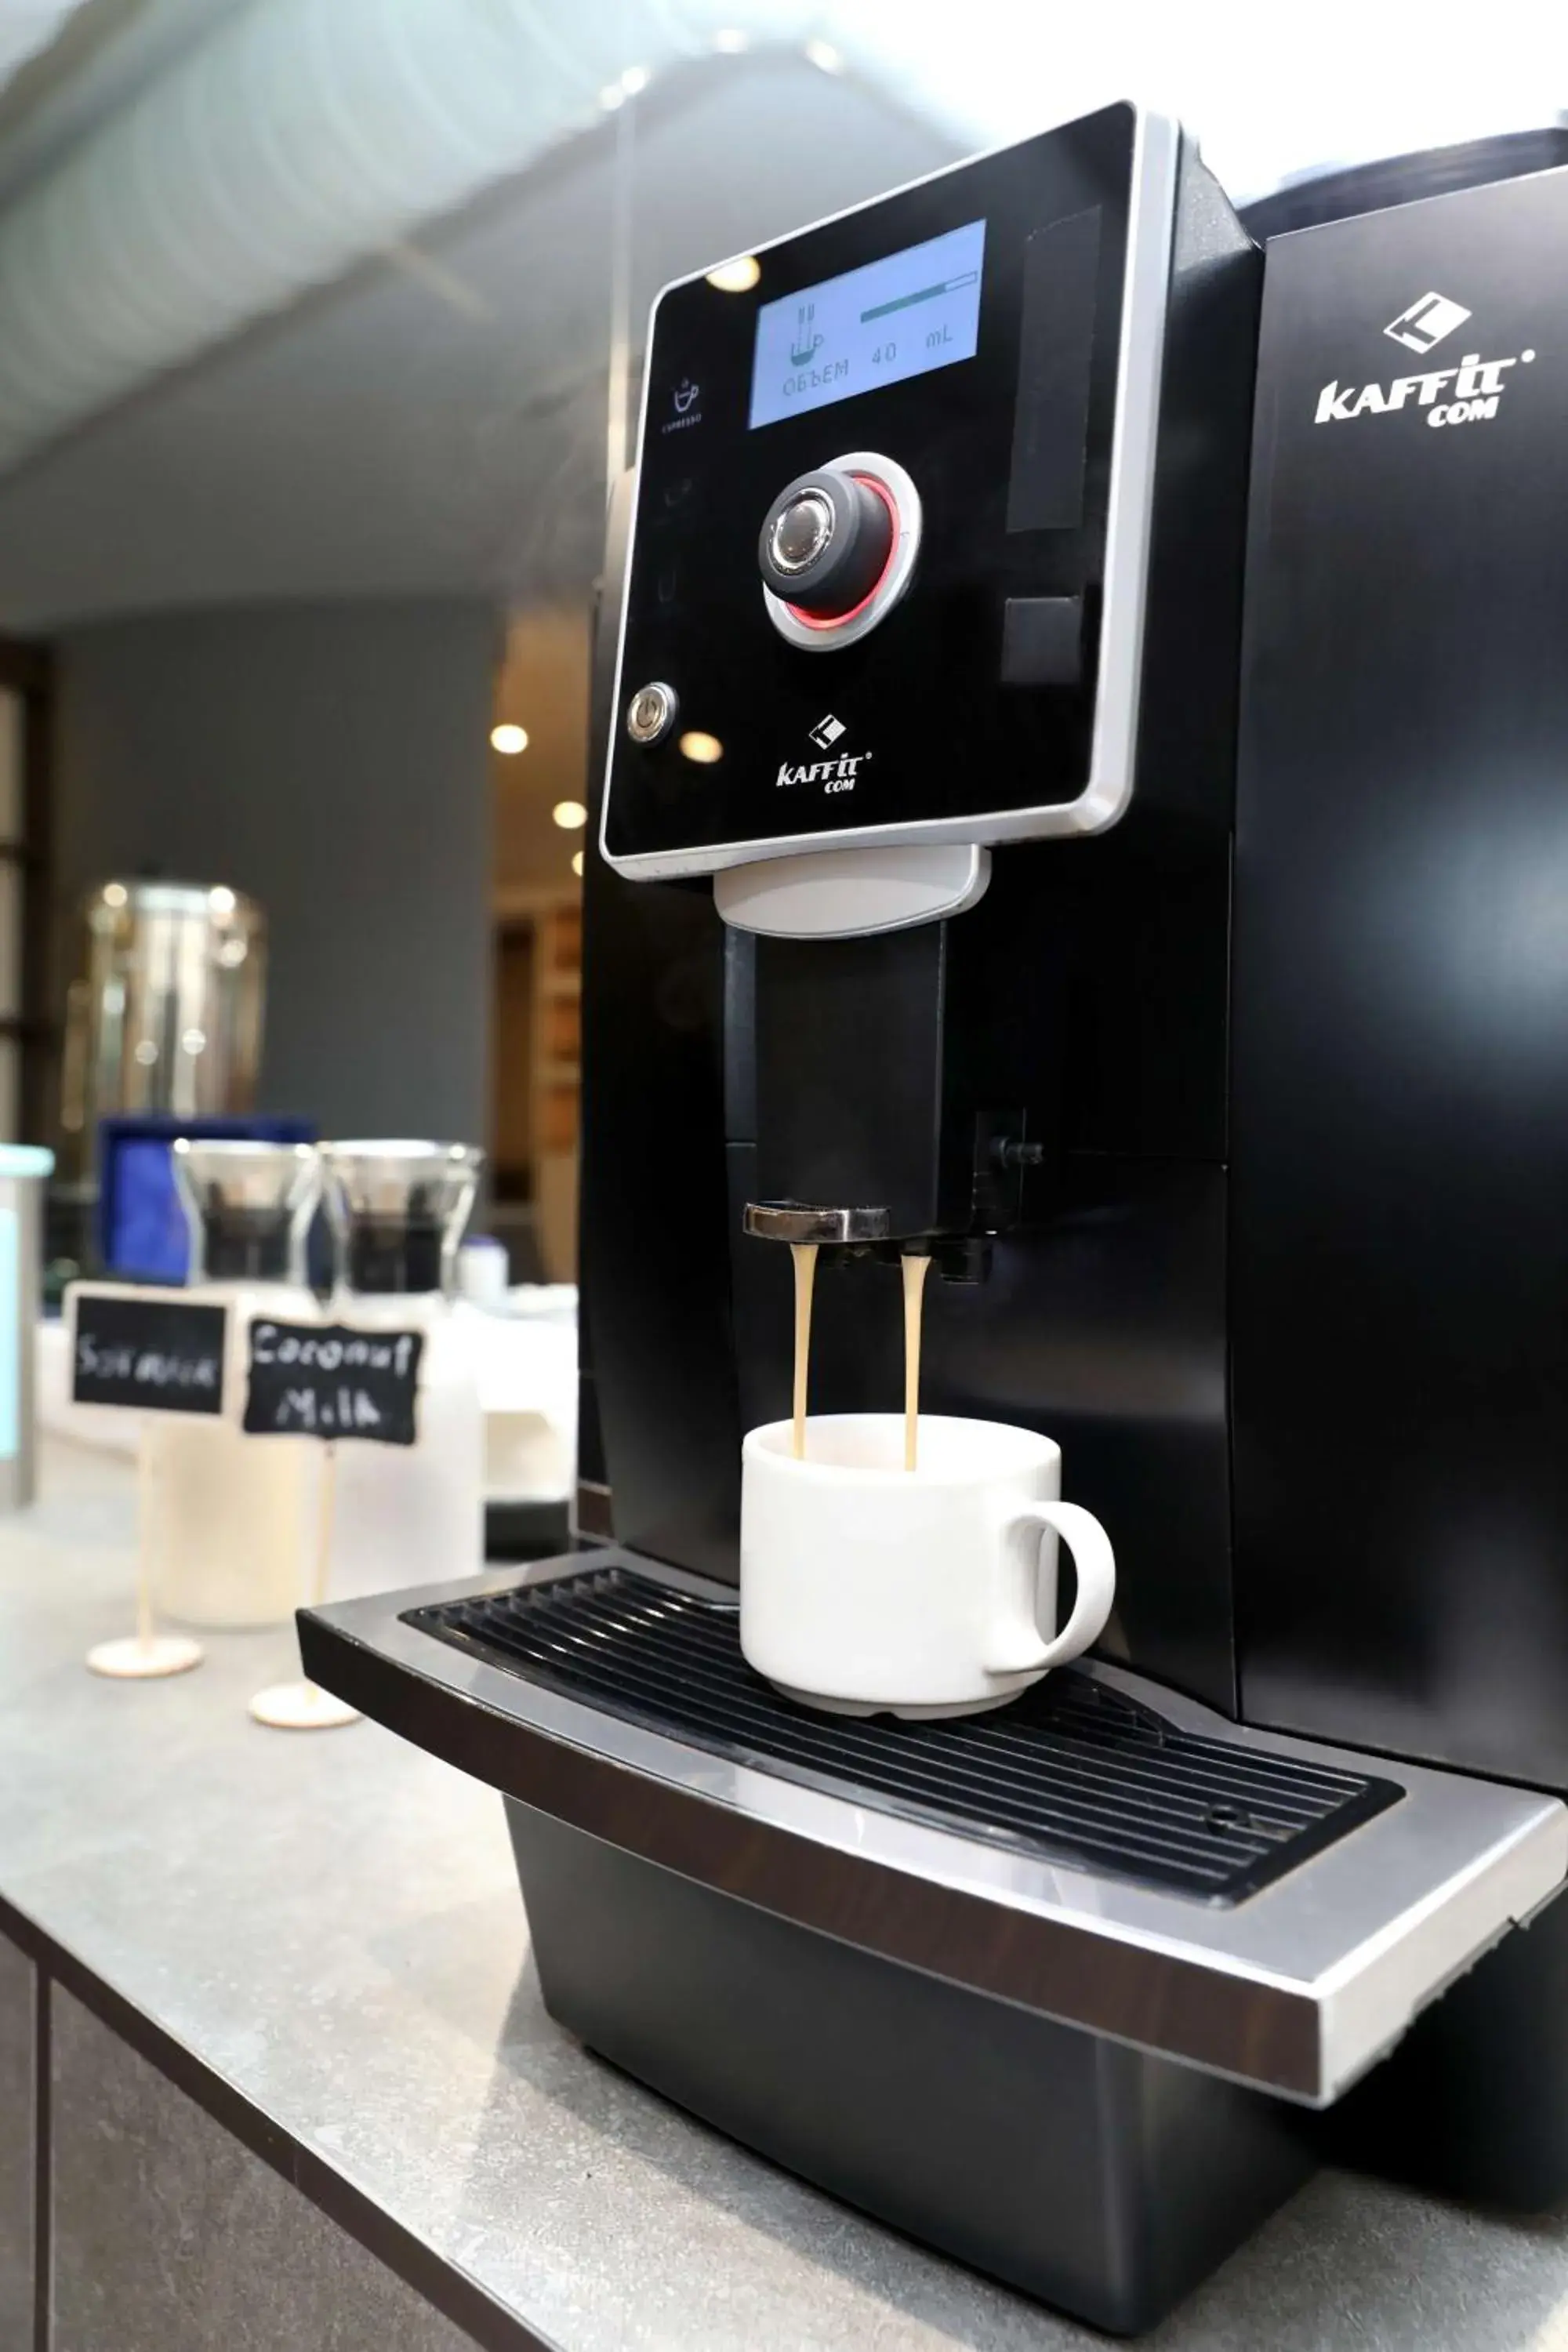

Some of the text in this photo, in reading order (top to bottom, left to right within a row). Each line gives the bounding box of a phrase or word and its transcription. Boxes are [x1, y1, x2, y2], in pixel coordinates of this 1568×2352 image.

[871, 343, 897, 365] 40
[1427, 396, 1500, 427] COM
[824, 778, 855, 794] COM
[254, 1325, 413, 1378] Coconut
